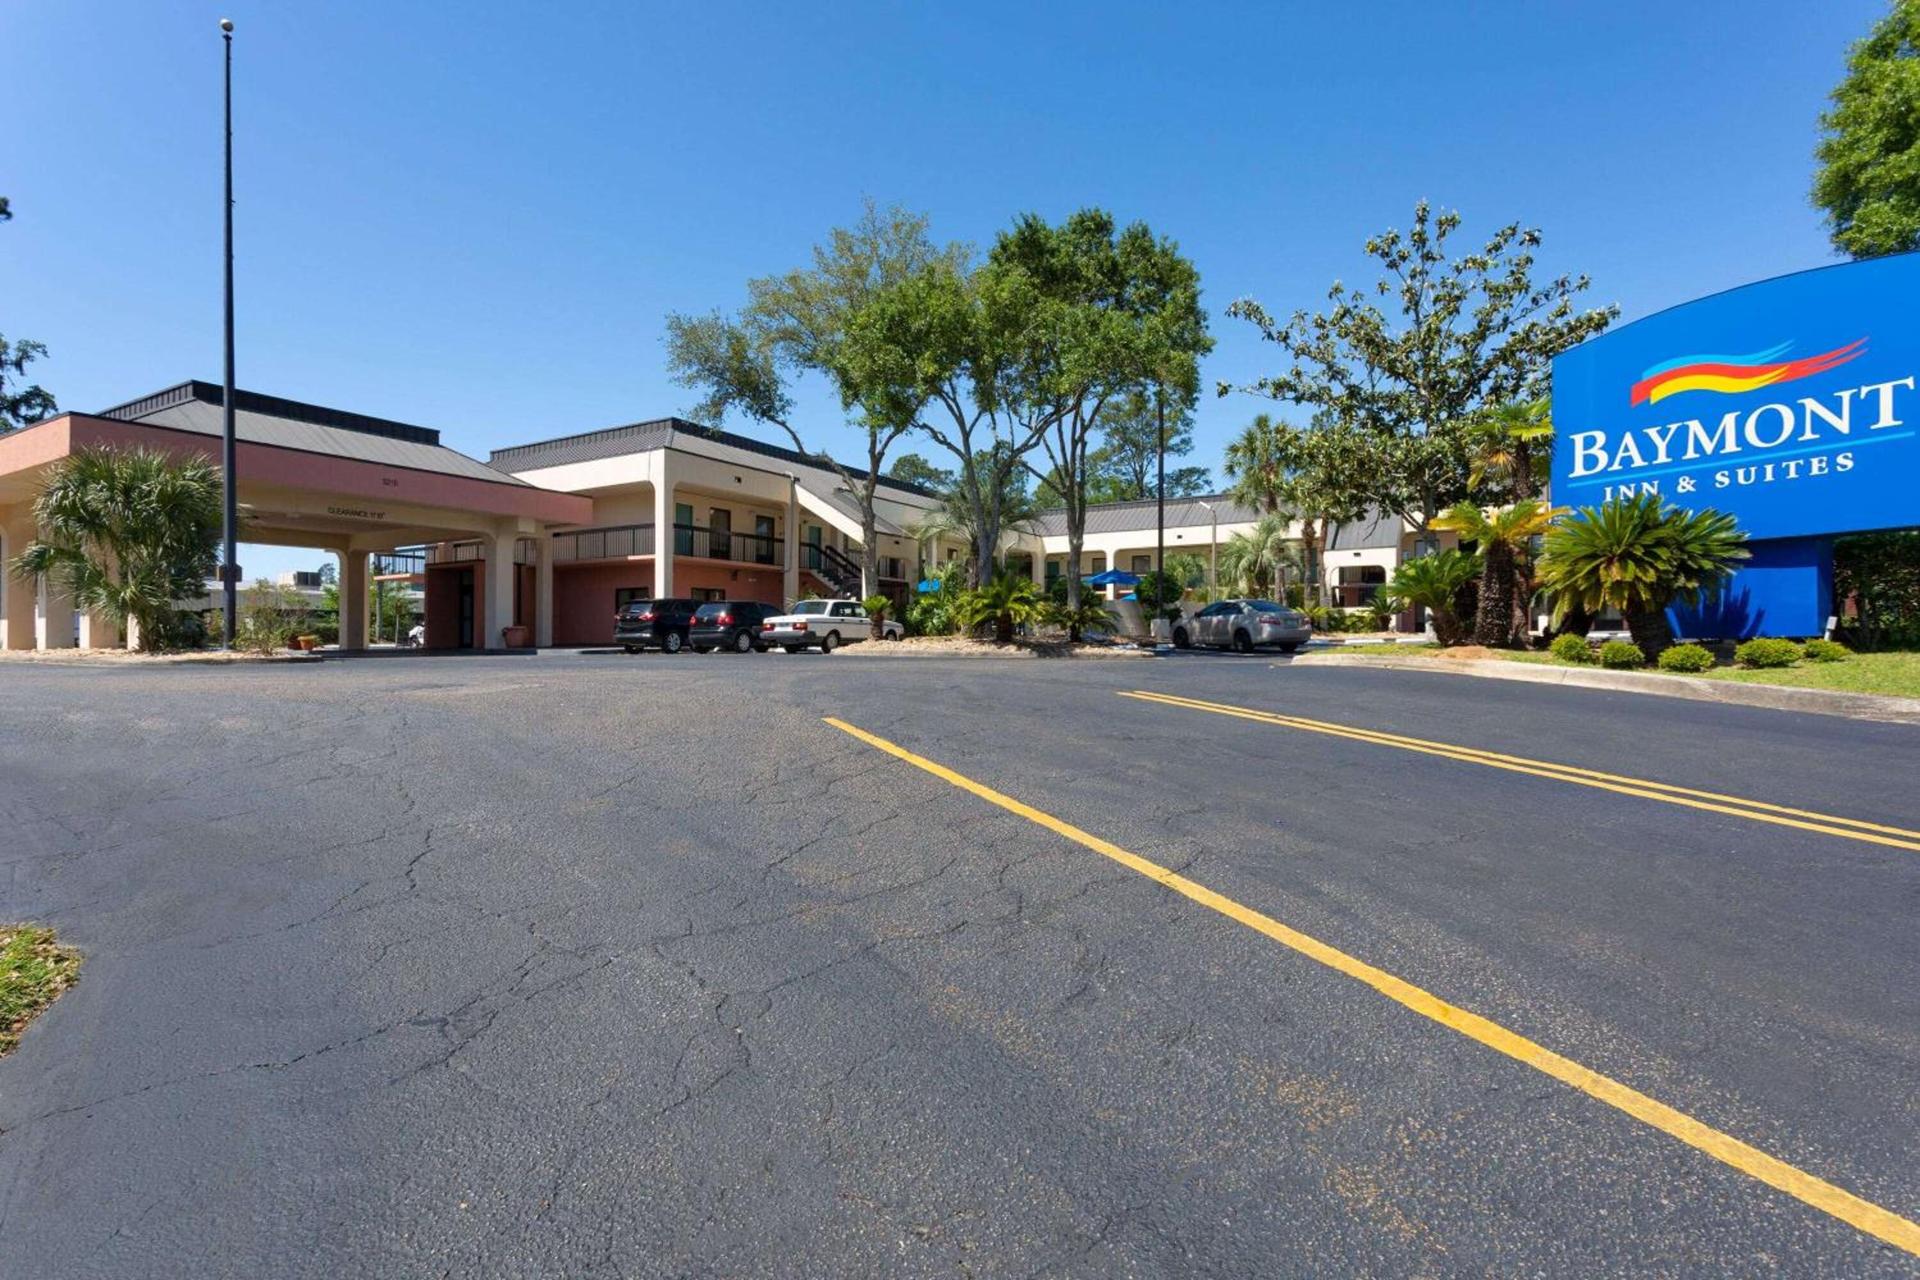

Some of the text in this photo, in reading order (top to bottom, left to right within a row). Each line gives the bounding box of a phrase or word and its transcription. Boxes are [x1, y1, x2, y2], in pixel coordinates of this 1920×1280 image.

[1568, 376, 1915, 479] BAYMONT
[1604, 452, 1855, 502] INN & SUITES
